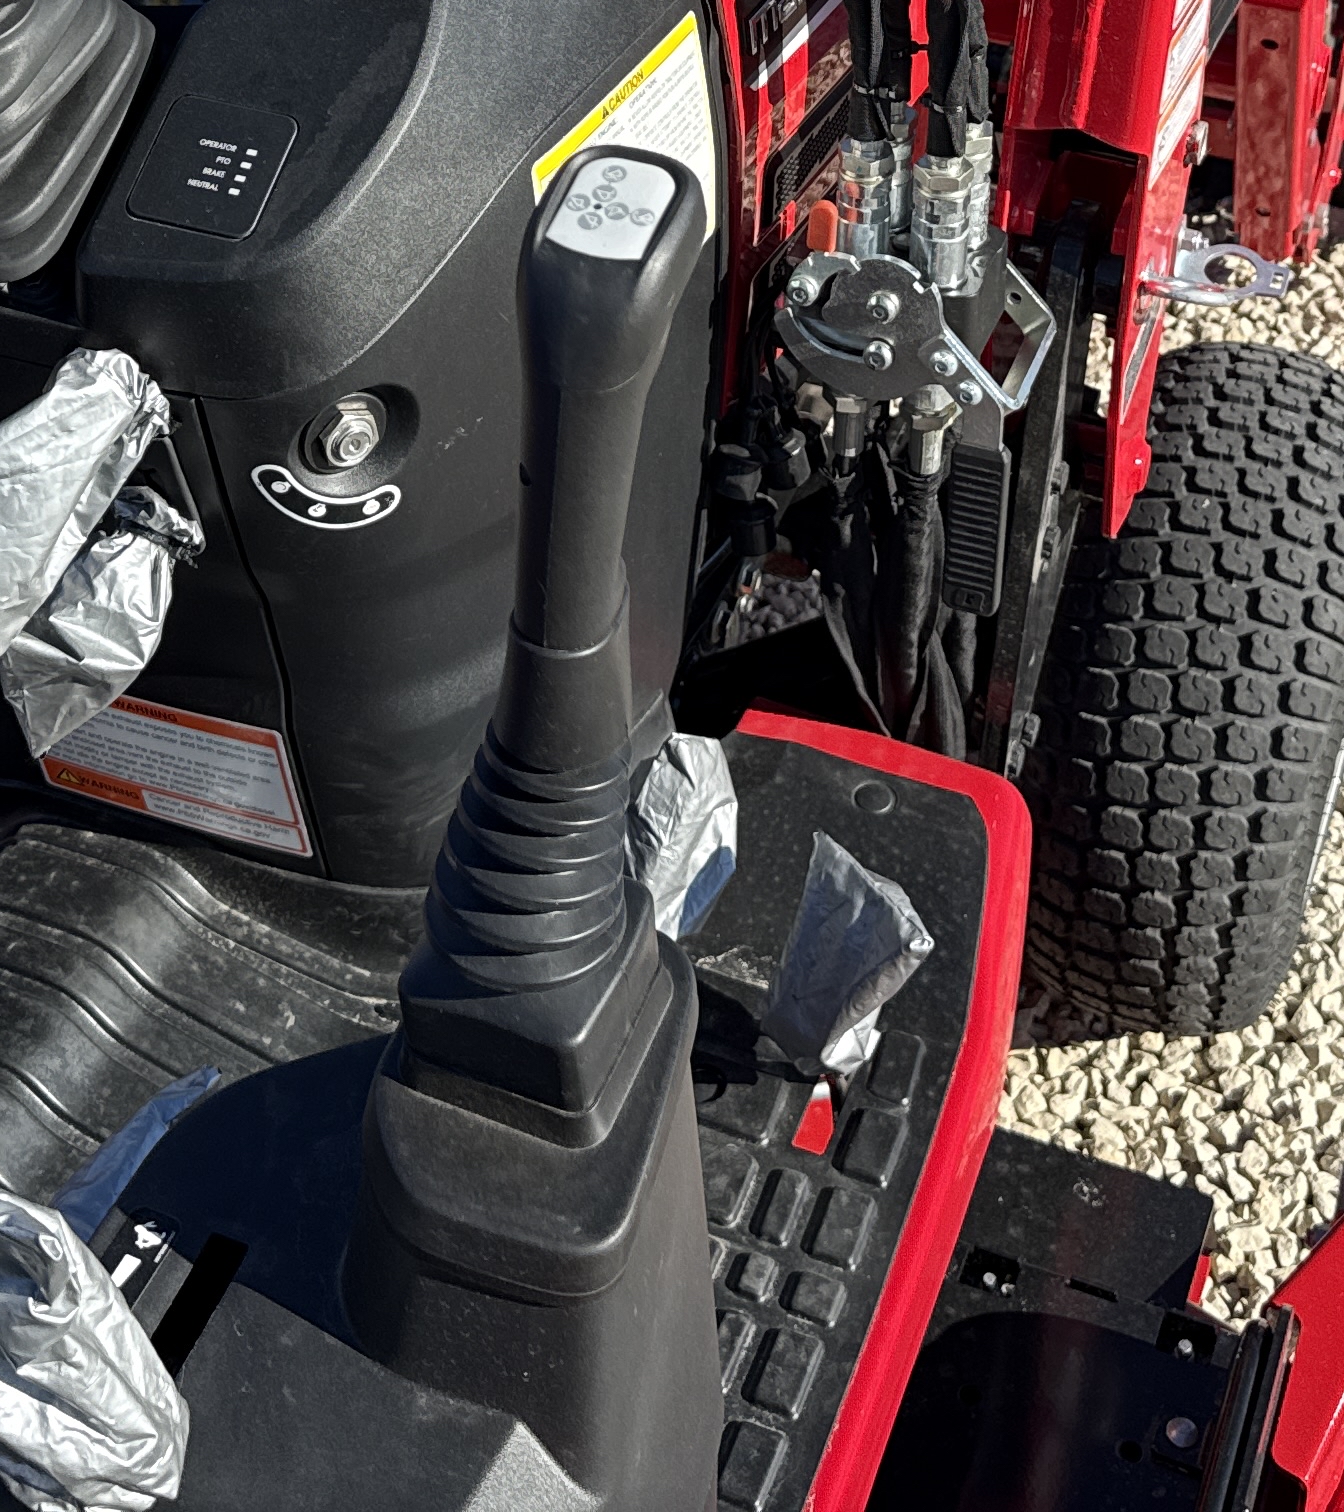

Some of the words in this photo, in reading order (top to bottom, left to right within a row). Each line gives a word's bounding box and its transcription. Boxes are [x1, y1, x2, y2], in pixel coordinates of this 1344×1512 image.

[608, 69, 644, 113] CAUTION
[199, 138, 238, 153] OPERATOR
[215, 155, 232, 165] PTO
[202, 167, 227, 179] BRAKE
[186, 178, 219, 192] NEUTRAL
